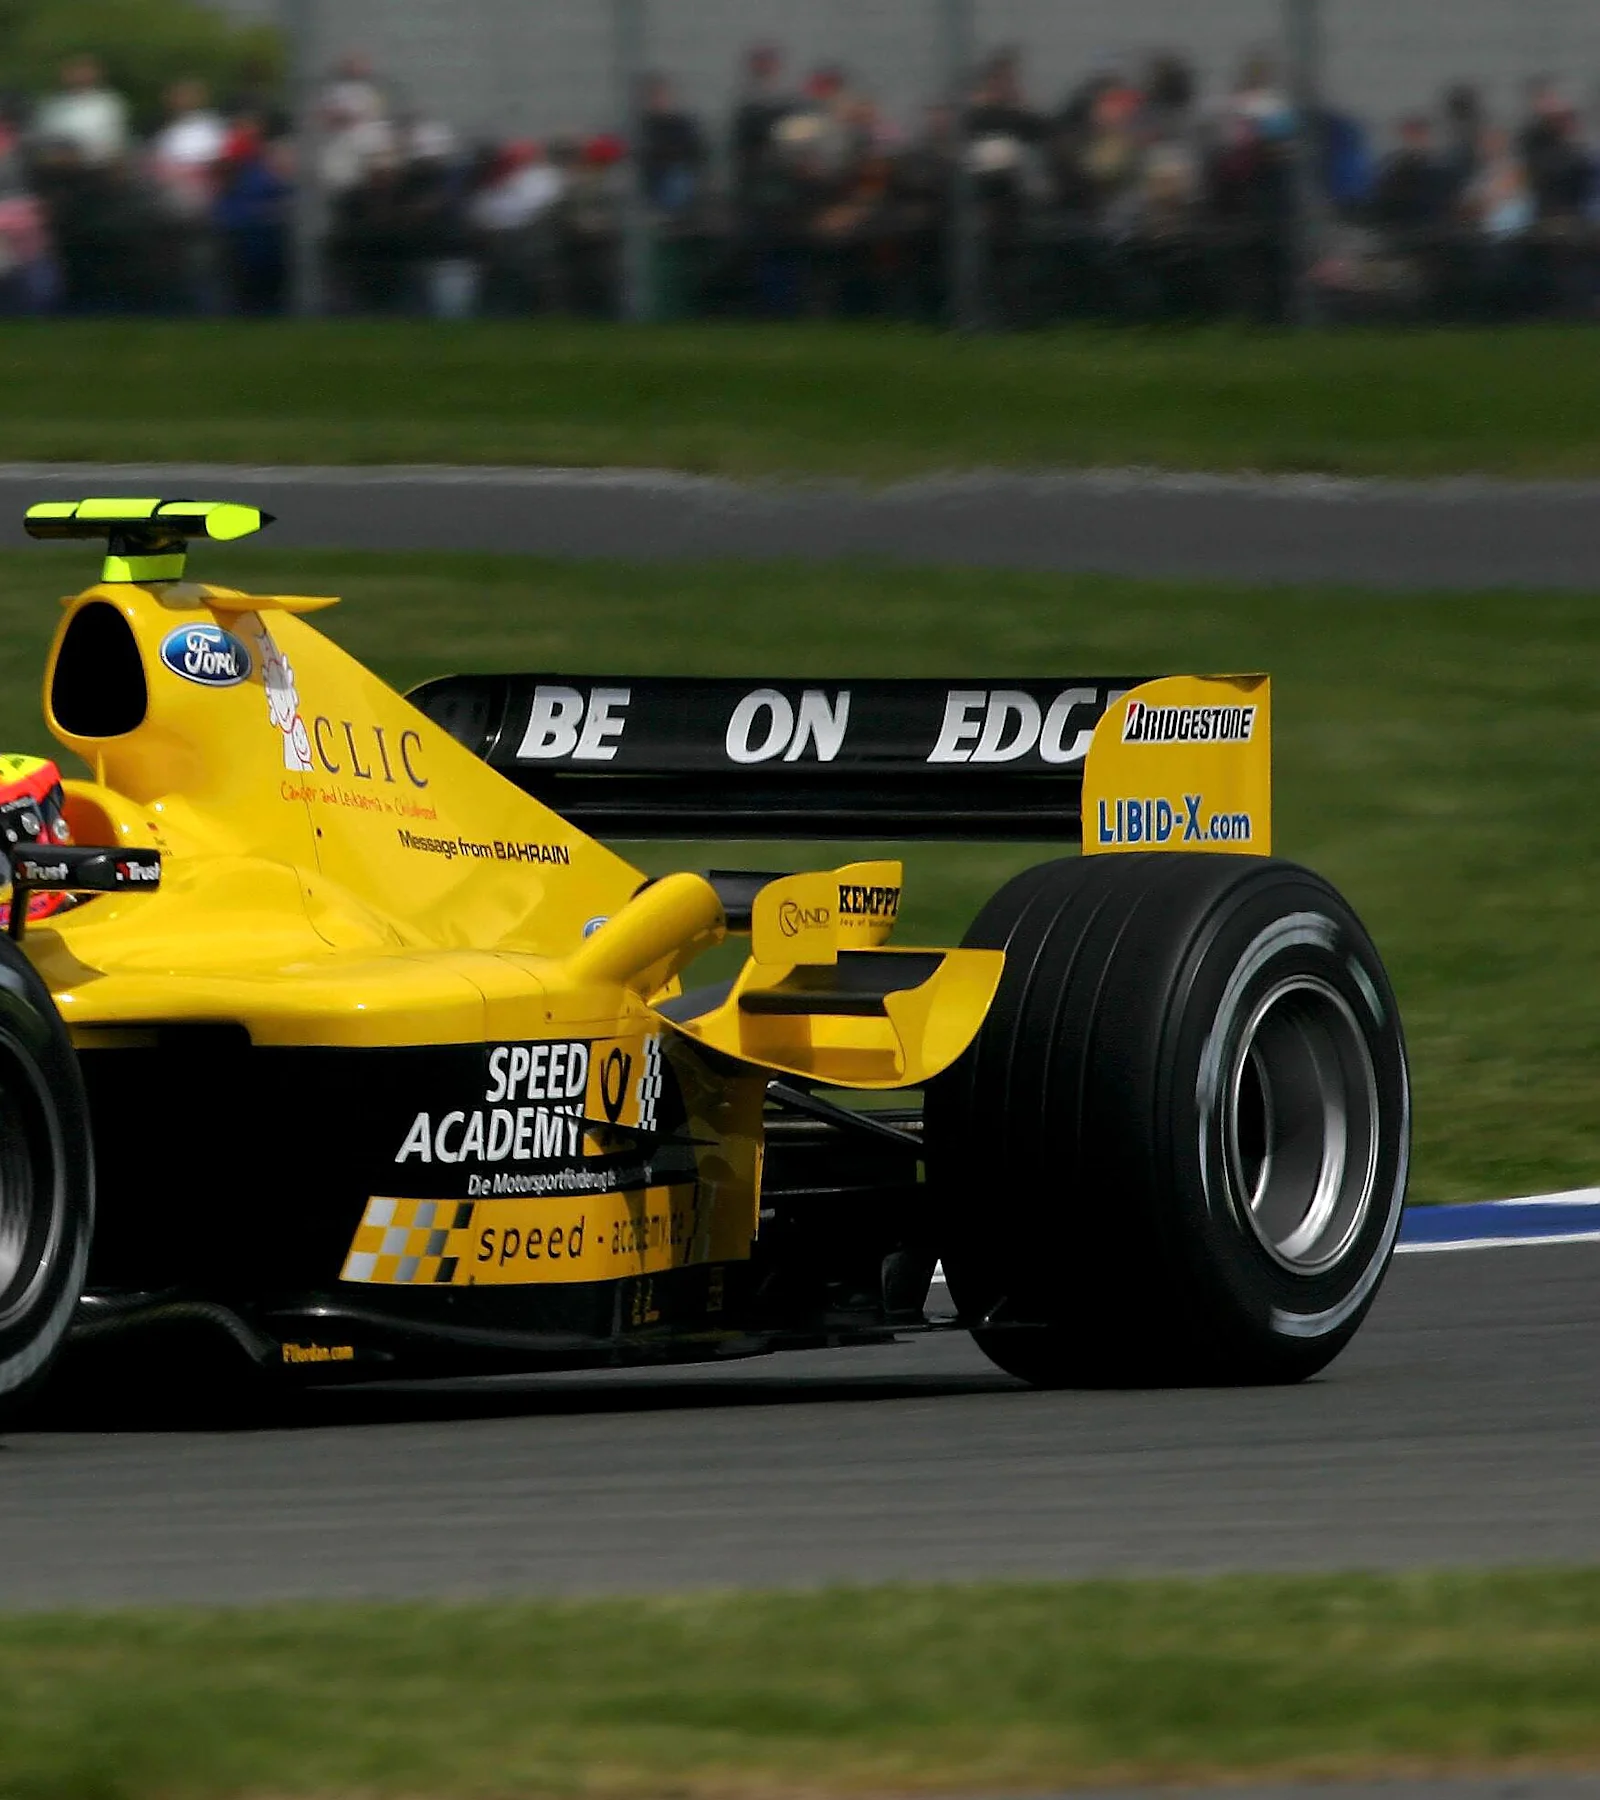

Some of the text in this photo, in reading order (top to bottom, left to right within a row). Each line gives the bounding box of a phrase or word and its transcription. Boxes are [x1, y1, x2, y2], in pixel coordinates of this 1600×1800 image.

[184, 631, 240, 677] Ford
[516, 685, 1127, 764] BE ON EDG
[1122, 701, 1256, 743] BRIDGESTONE
[314, 716, 428, 788] CLIC
[1098, 795, 1252, 844] LIBID-X.com
[23, 861, 68, 881] Trust
[398, 828, 570, 866] Message from BAHRAIN
[838, 884, 900, 916] KEMPPI
[485, 1043, 588, 1103] SPEED
[394, 1103, 585, 1164] ACADEMY
[477, 1215, 585, 1267] speed
